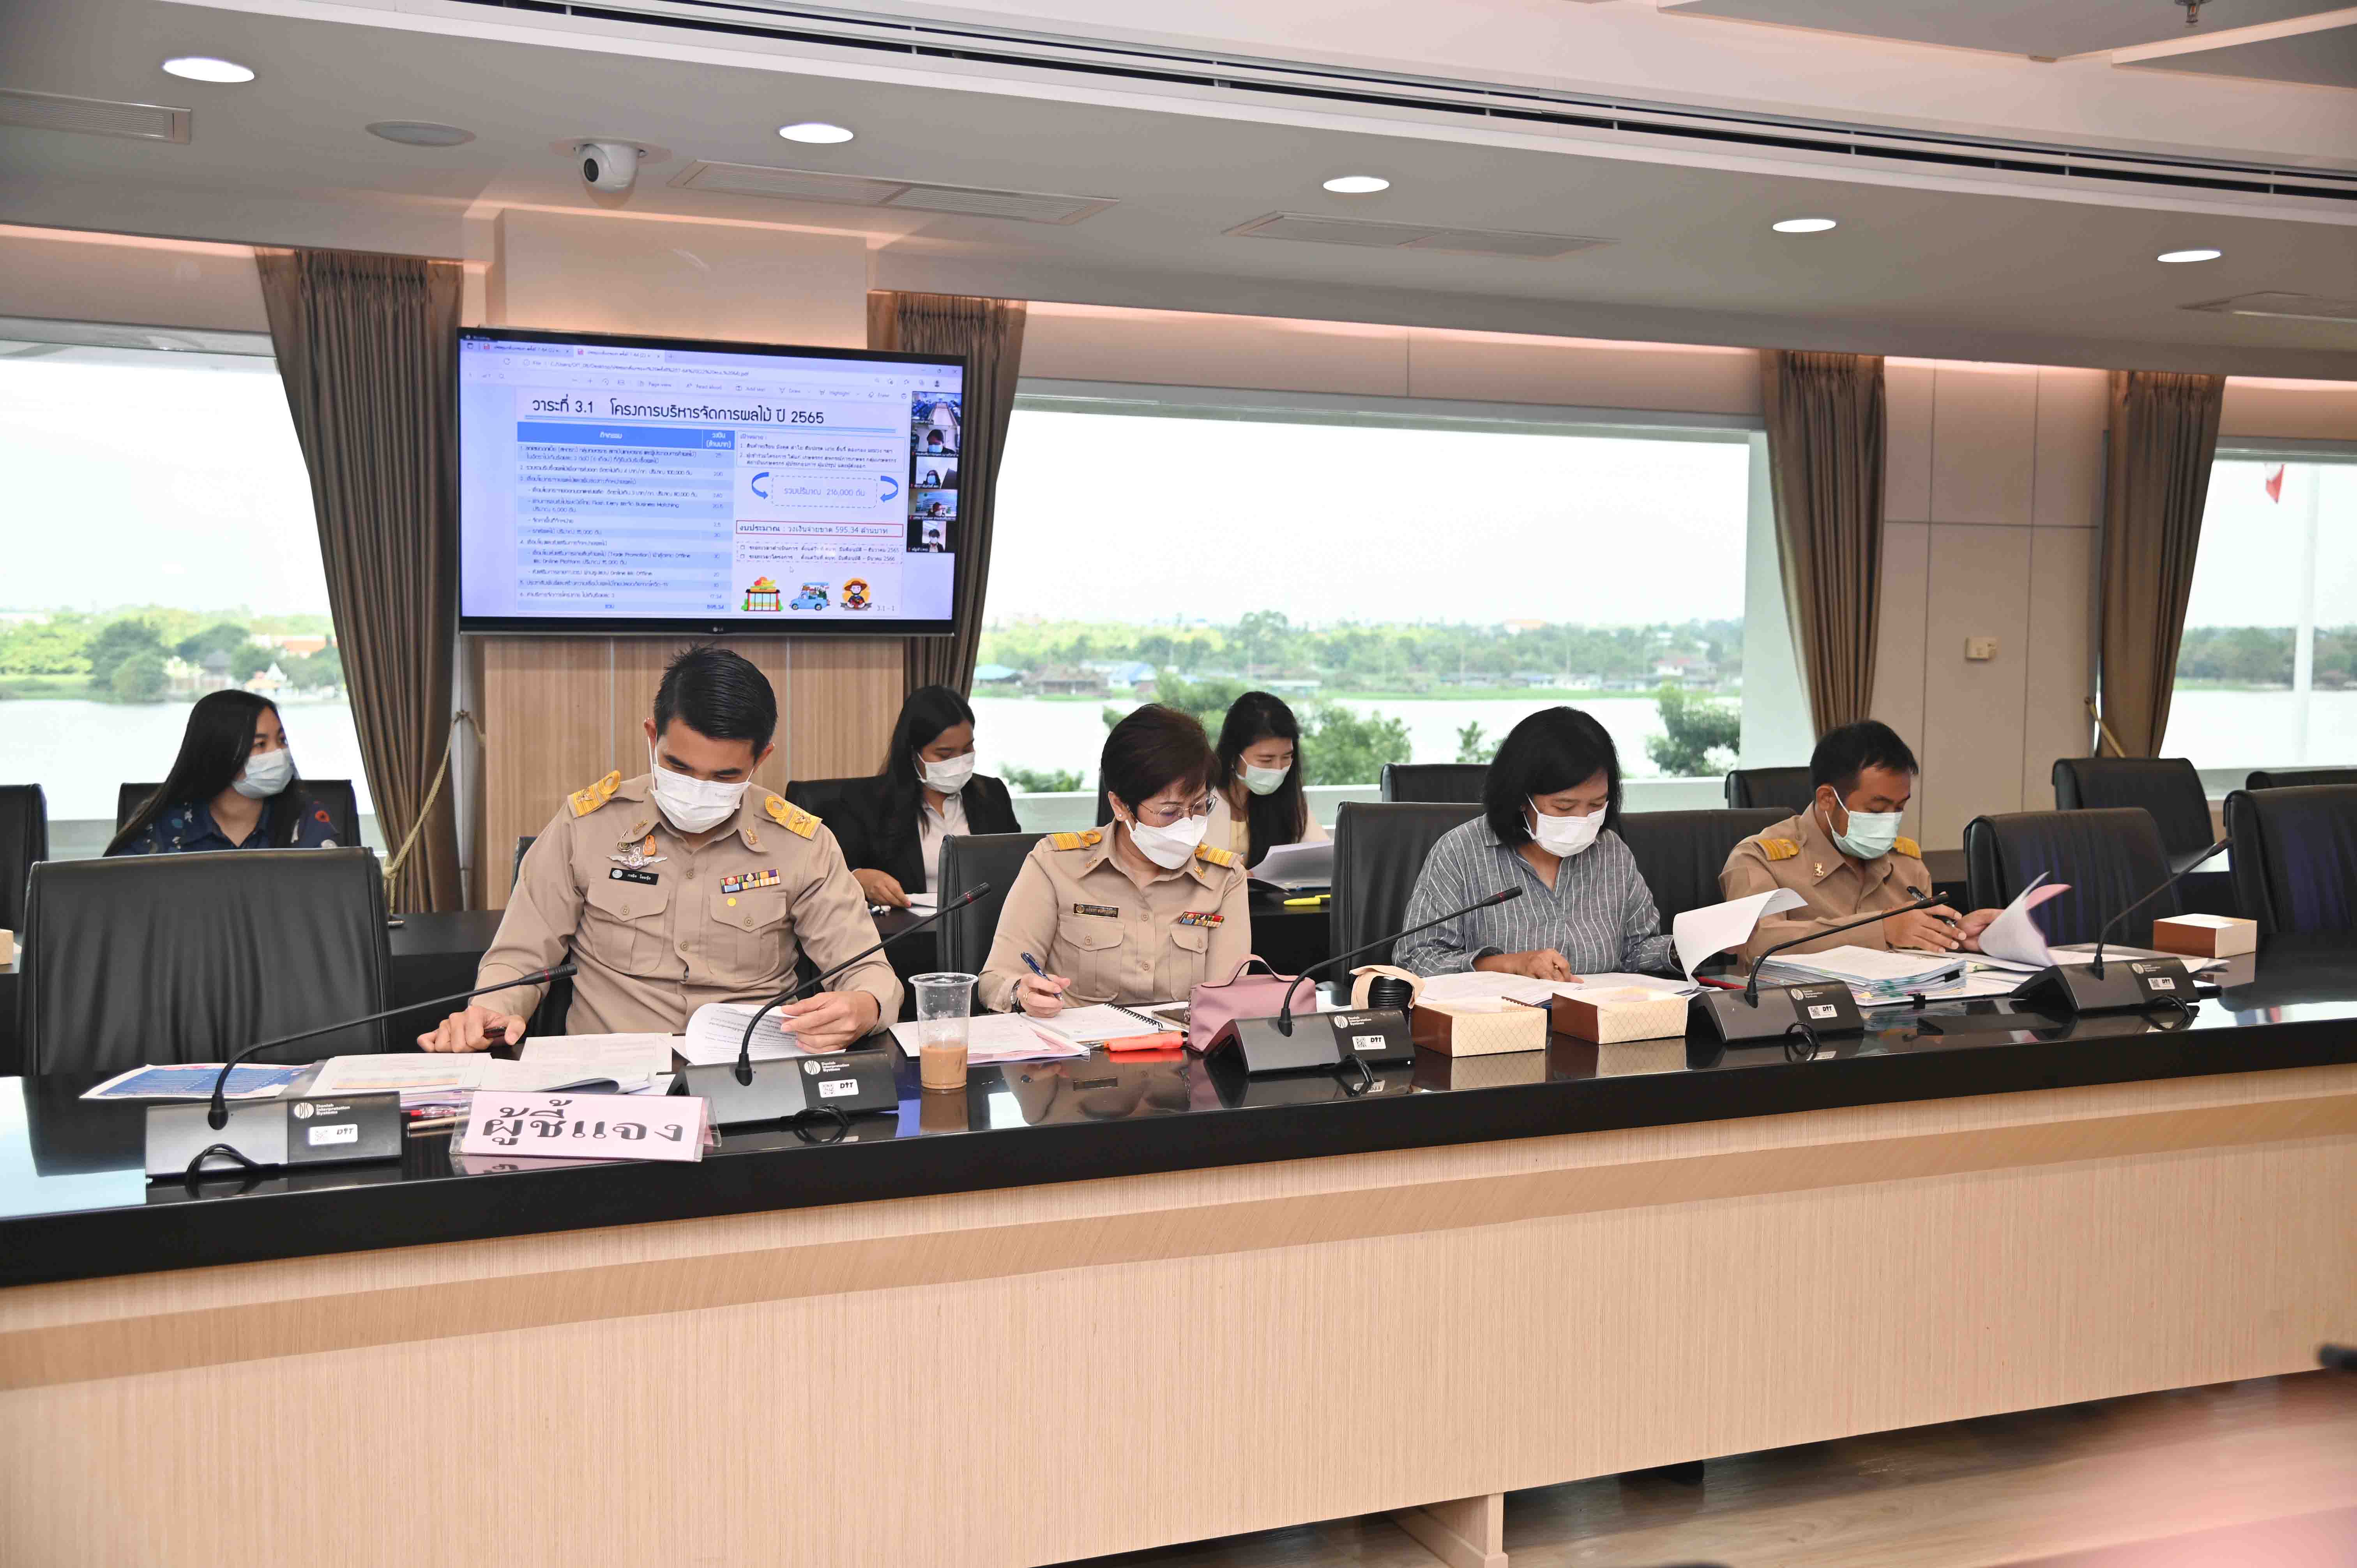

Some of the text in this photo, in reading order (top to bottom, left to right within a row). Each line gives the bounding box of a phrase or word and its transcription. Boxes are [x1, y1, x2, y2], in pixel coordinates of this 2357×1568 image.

[532, 394, 824, 424] วาระที่ 3.1 โครงการบริหารจัดการผลไม้ ปี 2565
[783, 487, 866, 497] รวมปริมาณ 216,000 ตัน
[483, 1099, 684, 1146] ผู้ชี้แจง
